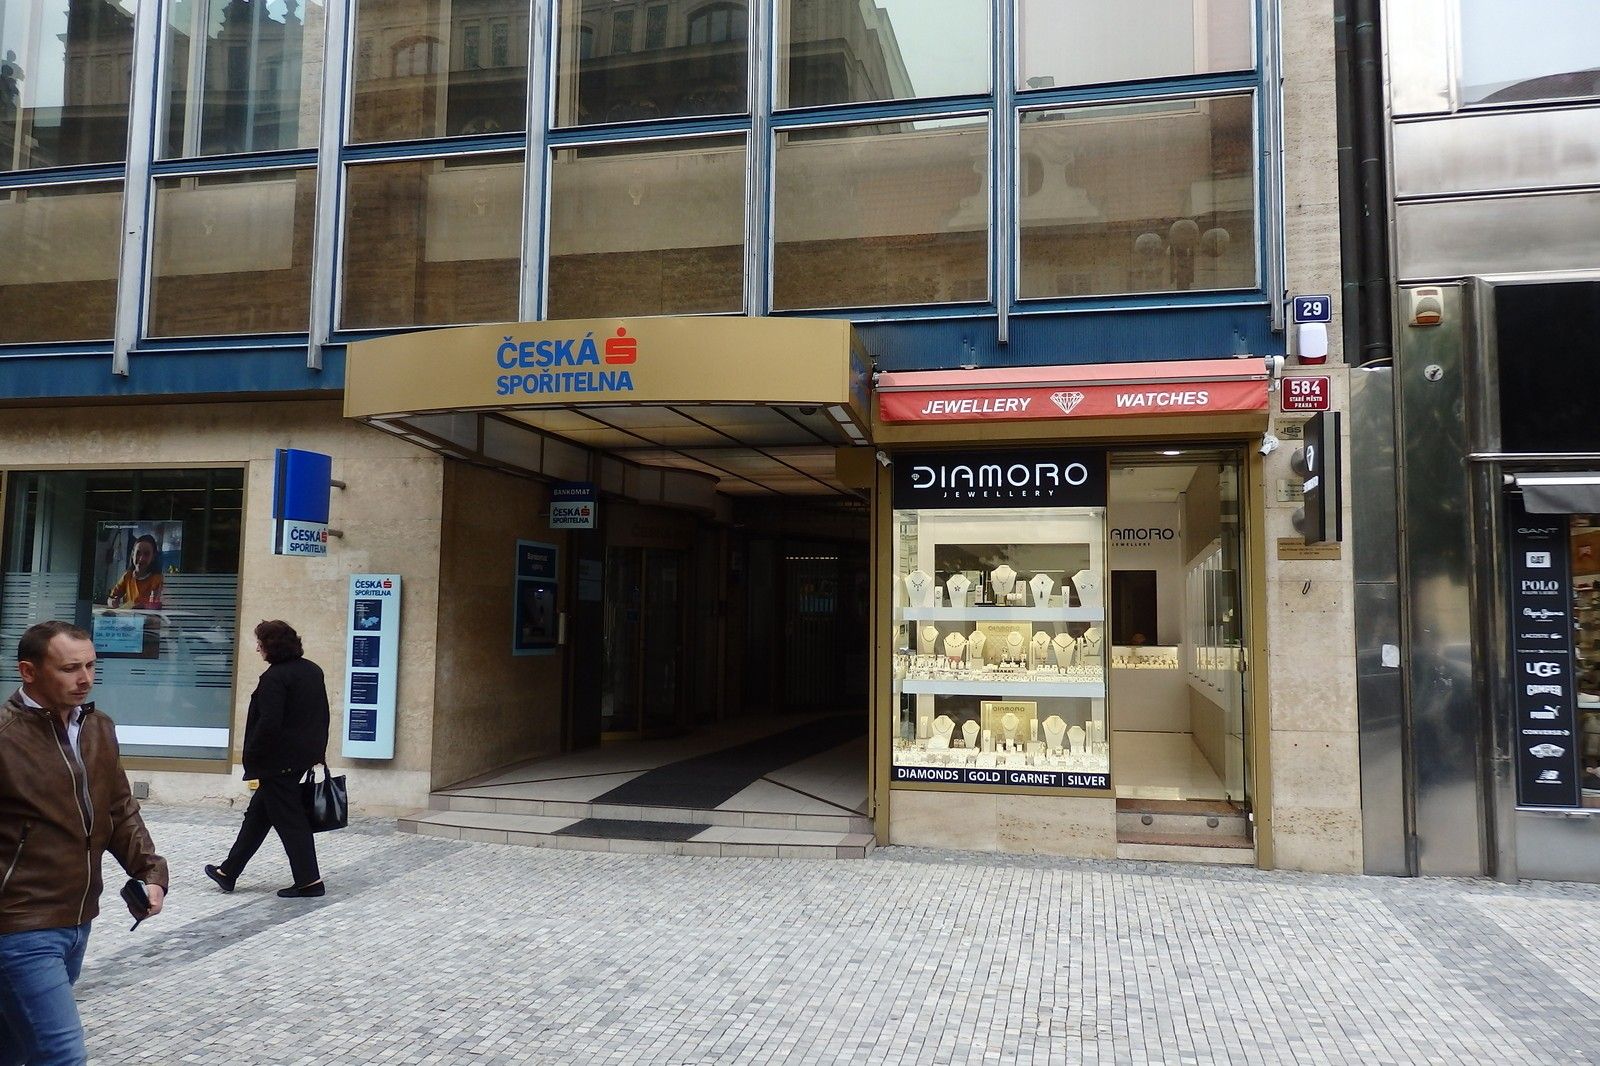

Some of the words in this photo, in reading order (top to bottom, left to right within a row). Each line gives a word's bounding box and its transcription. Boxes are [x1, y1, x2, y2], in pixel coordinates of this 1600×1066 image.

[1303, 302, 1322, 316] 29
[496, 332, 600, 369] ČESKÁ
[496, 368, 634, 396] SPOŘITELNA
[1291, 380, 1321, 395] 584
[921, 397, 1031, 415] JEWELLERY
[1116, 390, 1209, 408] WATCHES
[912, 462, 1088, 489] DIAMORO
[553, 488, 590, 496] BANKOMAT
[943, 489, 1054, 498] JEWELLERY
[553, 506, 580, 517] ČESKÁ
[291, 526, 321, 542] ČESKÁ
[289, 542, 327, 554] SPOŘITELNA
[355, 579, 383, 589] ČESKÁ
[1521, 580, 1559, 590] POLO
[355, 589, 392, 597] SPOŘITELNA
[1525, 661, 1561, 677] UGG
[897, 768, 959, 781] DIAMONDS
[968, 770, 1001, 782] GOLD
[1010, 772, 1057, 785] GARNET
[1067, 774, 1106, 787] SILVER
